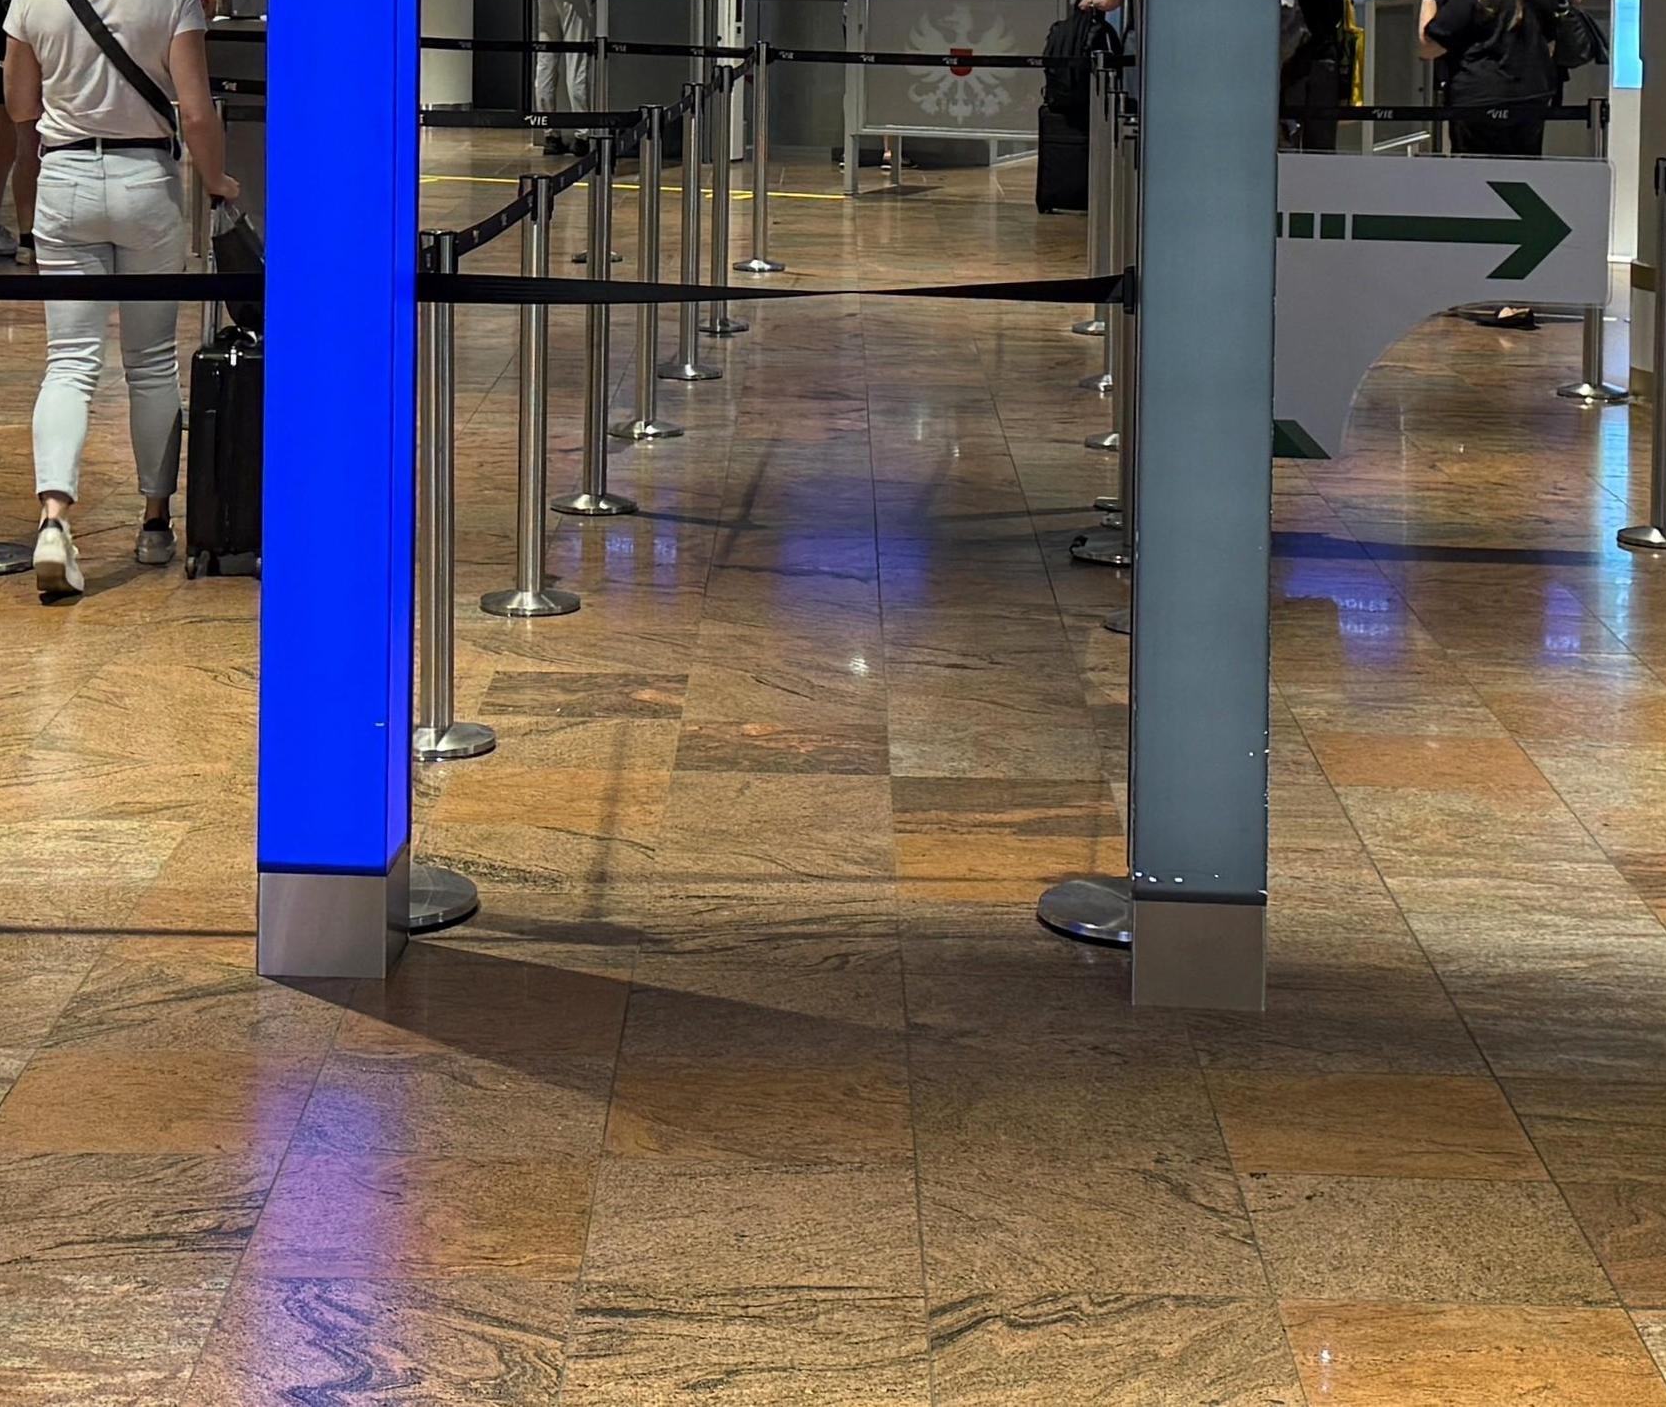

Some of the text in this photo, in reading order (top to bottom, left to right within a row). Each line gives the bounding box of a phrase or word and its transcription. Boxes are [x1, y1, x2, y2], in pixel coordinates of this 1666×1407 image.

[1373, 109, 1394, 120] VIE
[1489, 108, 1510, 120] VIE
[526, 115, 549, 126] VIE
